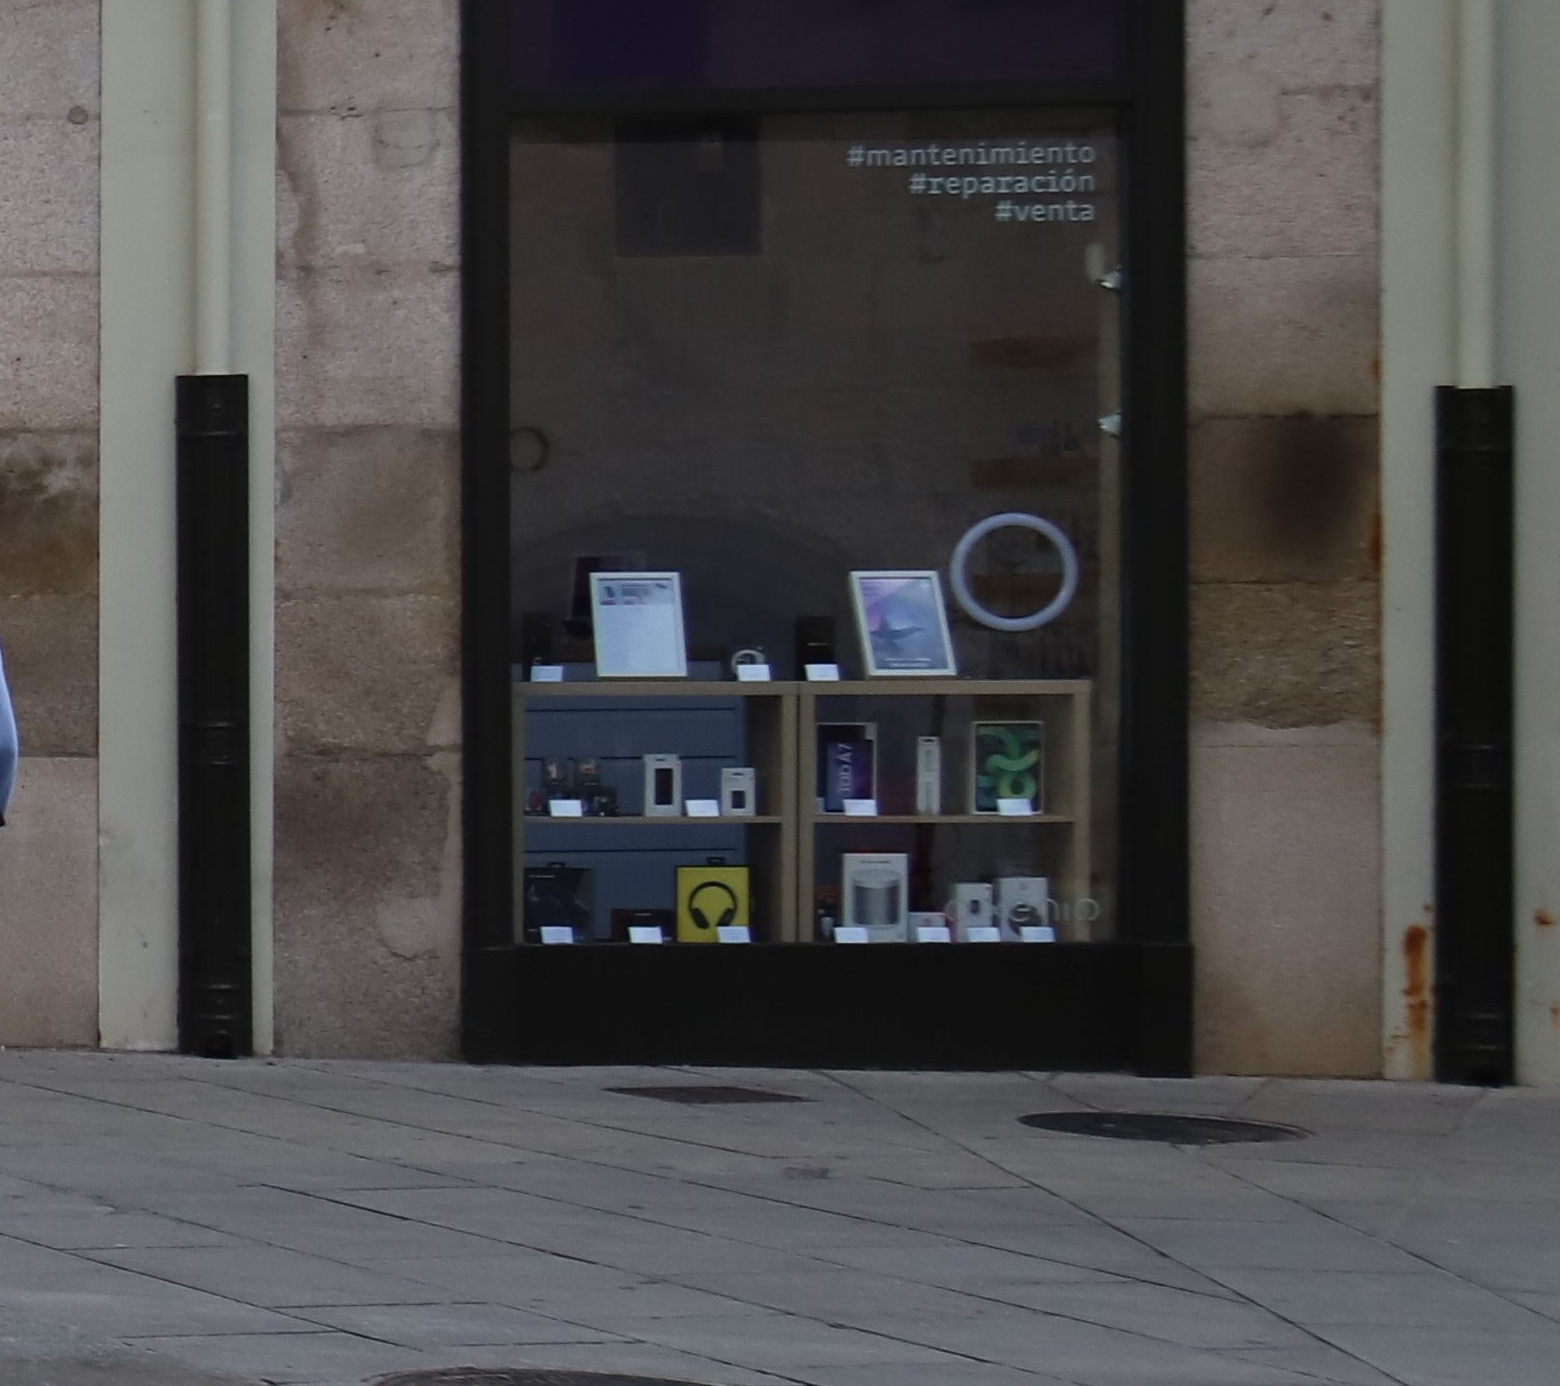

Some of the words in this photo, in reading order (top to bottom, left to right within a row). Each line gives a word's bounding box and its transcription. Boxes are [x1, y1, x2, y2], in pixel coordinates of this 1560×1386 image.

[845, 141, 1097, 167] #mantenimiento
[908, 168, 1096, 200] #reparación
[993, 198, 1096, 222] #venta
